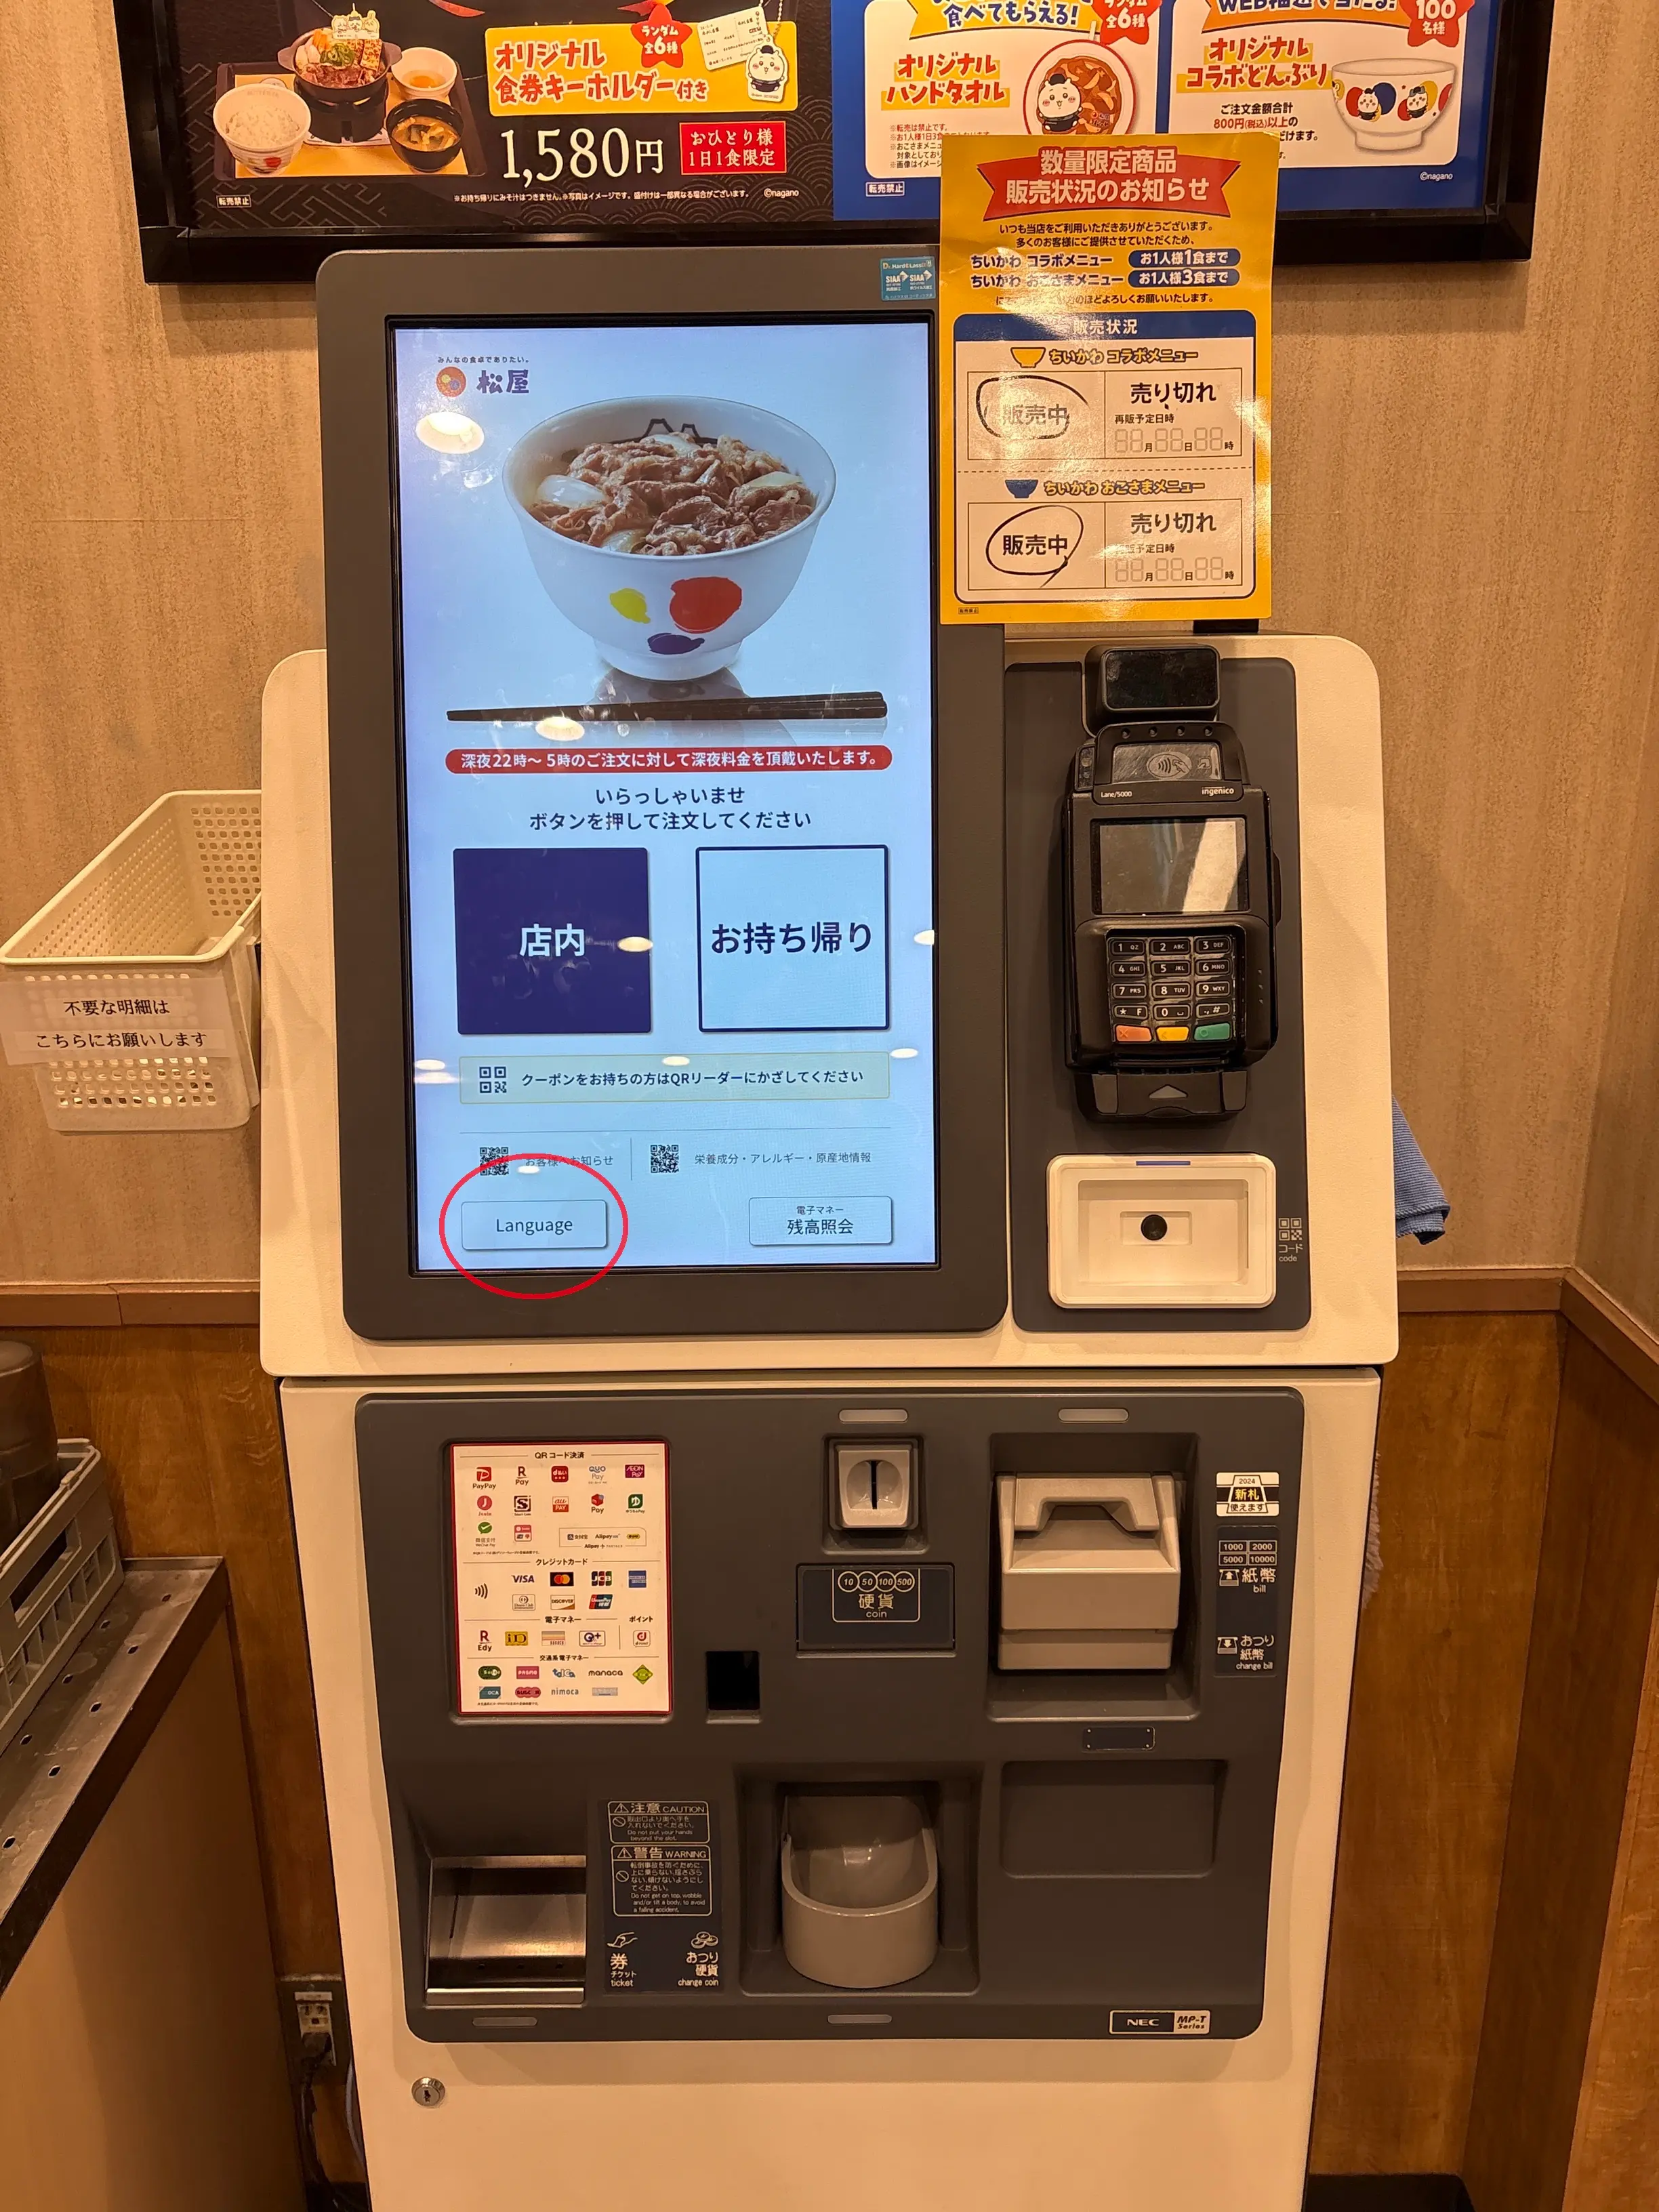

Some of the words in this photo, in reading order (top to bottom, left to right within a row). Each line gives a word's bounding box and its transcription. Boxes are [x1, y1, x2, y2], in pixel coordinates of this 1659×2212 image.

[944, 3, 1078, 27] 食べてもらえる!
[1106, 9, 1145, 28] 全6種
[641, 24, 678, 36] ランダム
[1422, 22, 1446, 35] 名様
[644, 37, 678, 54] 全6種
[1208, 37, 1309, 61] オリジナル
[495, 40, 605, 70] オリジナル
[896, 52, 997, 77] オリジナル
[1187, 63, 1329, 89] コラボどんぶり
[495, 70, 708, 104] 食券キーホルダー付き
[885, 81, 1006, 104] ハンドタオル
[1221, 102, 1294, 115] ご注文金額合計
[691, 127, 774, 146] おひとり様
[501, 127, 663, 188] 1,580円
[689, 148, 775, 167] 1日1食限定
[1040, 148, 1176, 176] 数量限定商品
[869, 184, 903, 194] 転売禁止
[1005, 178, 1209, 205] 販売状況のお知らせ
[217, 196, 250, 206] 転売禁止
[999, 221, 1214, 234] いつも当店をご利用いただきありがとうございます。
[1016, 234, 1195, 247] 多くのお客様にご提供させていただくため、
[970, 254, 1022, 269] ちいかわ
[1027, 254, 1113, 267] コラボメニュー
[1140, 249, 1229, 266] お1人様1食まで
[1139, 268, 1229, 286] お1人様3食まで
[1072, 320, 1138, 335] 販売状況
[1049, 348, 1104, 365] ちいかわ
[1107, 347, 1199, 363] コラボメニュー
[476, 369, 529, 394] 松屋
[1130, 382, 1216, 404] 売り切れ
[1115, 413, 1174, 424] 再販予定日時
[1044, 480, 1099, 496] ちいかわ
[1101, 480, 1205, 495] おこさまメニュー
[1130, 512, 1216, 534] 売り切れ
[1002, 534, 1068, 556] 販売中
[595, 786, 745, 805] いらっしゃいませ
[1202, 786, 1235, 796] ingenico
[529, 811, 812, 831] ボタンを押して注文してください
[519, 923, 585, 957] 店内
[710, 921, 873, 955] お持ち帰り
[1160, 943, 1166, 951] 2
[1118, 965, 1125, 973] 4
[1160, 964, 1167, 972] 5
[1202, 964, 1209, 972] 6
[1161, 987, 1168, 995] 8
[1202, 985, 1209, 993] 9
[64, 998, 170, 1017] 不要な明細は
[36, 1031, 207, 1048] こちらにお願いします
[521, 1069, 864, 1086] クーポンをお持ちの方はQRリーダーにかざしてください
[796, 1206, 844, 1216] 電子マネー
[495, 1218, 573, 1235] Language
[787, 1218, 854, 1236] 残高照会
[1278, 1244, 1303, 1254] コード
[1235, 1489, 1260, 1501] 新札
[1230, 1503, 1265, 1513] 使えます
[1223, 1542, 1244, 1551] 1000
[1252, 1542, 1273, 1551] 2000
[535, 1557, 588, 1567] クレジットカード
[1223, 1555, 1244, 1563] 5000
[1250, 1555, 1275, 1563] 10000
[512, 1574, 535, 1583] VISA
[844, 1578, 854, 1586] 10
[861, 1578, 873, 1586] 50
[878, 1578, 893, 1586] 100
[897, 1578, 912, 1586] 500
[1242, 1568, 1276, 1584] 紙幣
[1253, 1584, 1266, 1593] bill
[858, 1593, 894, 1610] 硬貨
[544, 1616, 582, 1624] 電子マネー
[629, 1616, 653, 1624] ポイント
[865, 1610, 888, 1618] coin
[478, 1644, 492, 1652] Edy
[1240, 1634, 1275, 1647] おつり
[1240, 1648, 1264, 1660] 紙幣
[1236, 1662, 1261, 1671] change
[551, 1687, 579, 1696] nimoca
[631, 1803, 661, 1814] 注意
[610, 1952, 628, 1970] 券
[686, 1951, 718, 1963] おつり
[695, 1964, 718, 1977] 硬貨
[611, 1978, 634, 1987] ticket
[678, 1978, 703, 1987] change
[704, 1978, 719, 1987] coin
[1127, 2018, 1160, 2026] NEC
[1176, 2015, 1207, 2024] MP-T
